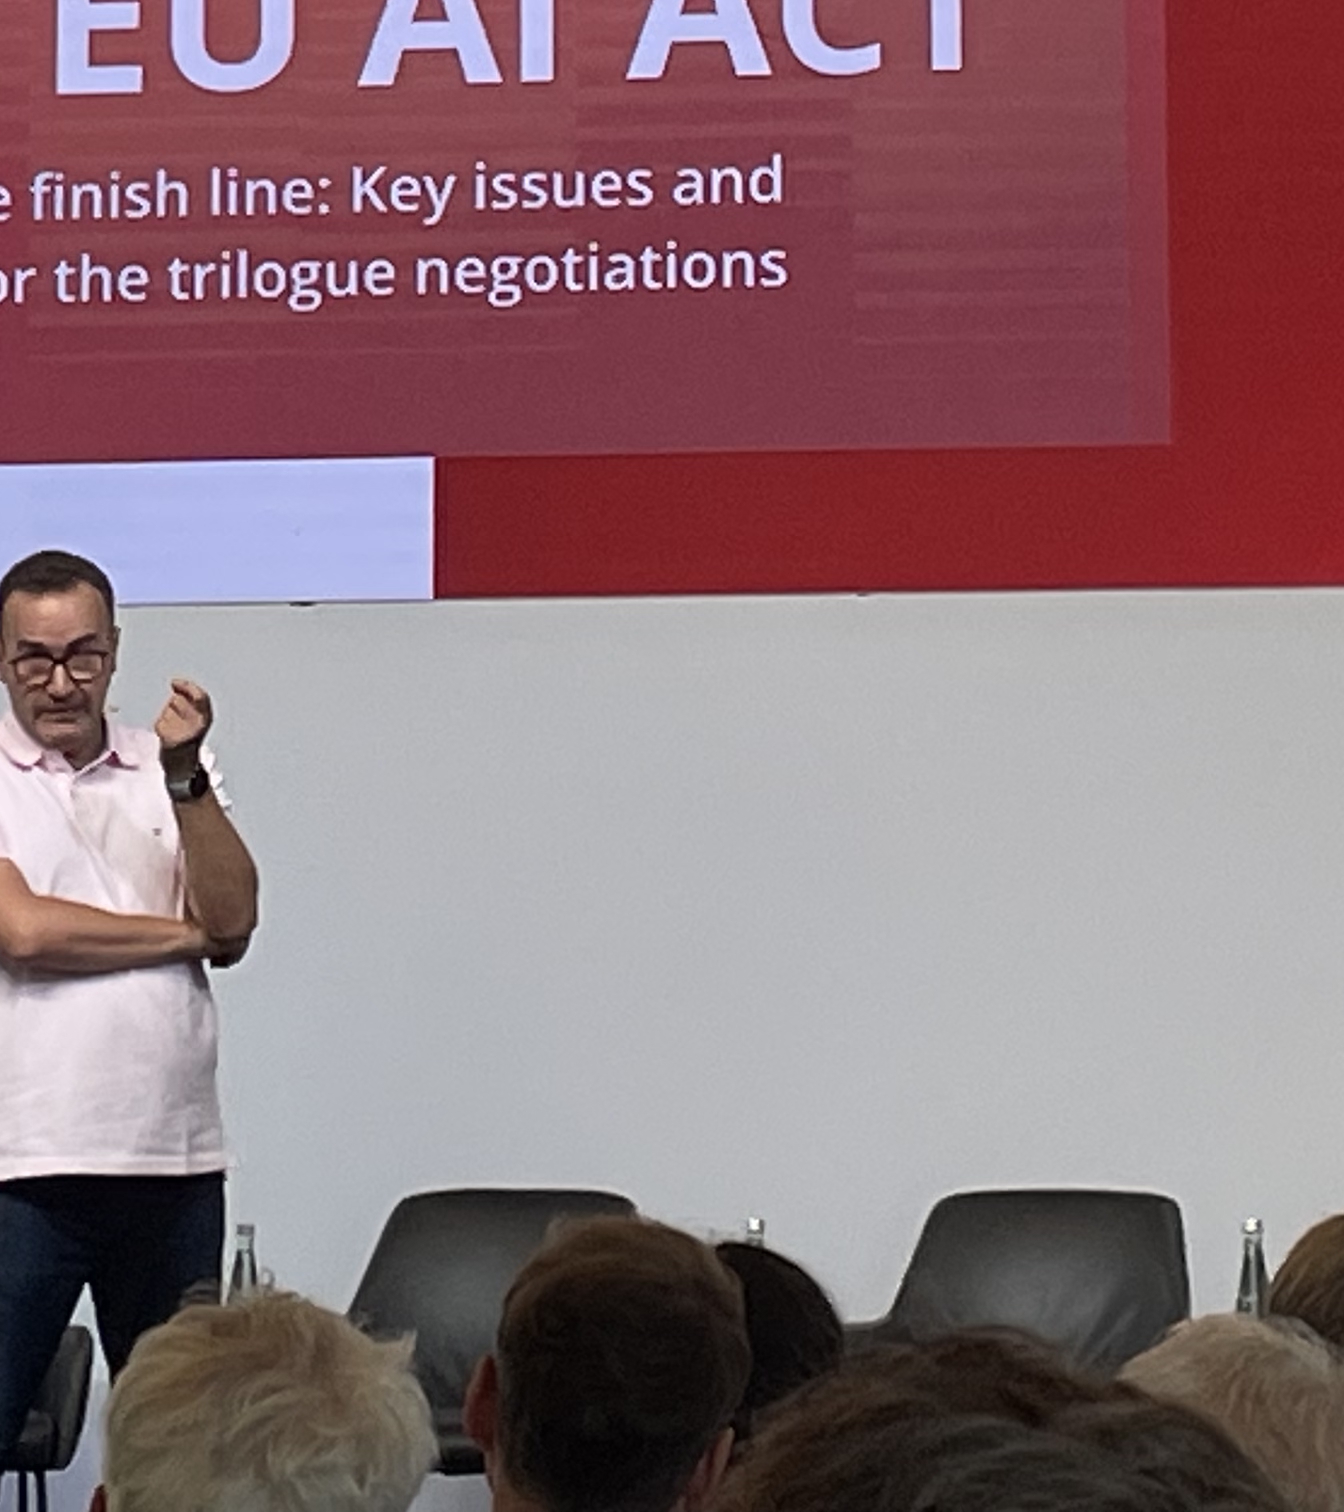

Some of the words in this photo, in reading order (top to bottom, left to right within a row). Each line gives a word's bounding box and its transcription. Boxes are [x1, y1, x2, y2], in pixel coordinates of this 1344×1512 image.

[29, 168, 189, 221] finish
[210, 166, 332, 216] line:
[352, 165, 458, 226] Key
[474, 160, 654, 210] issues
[672, 152, 783, 206] and
[53, 252, 150, 303] the
[167, 248, 396, 312] trilogue
[416, 239, 788, 308] negotiations
